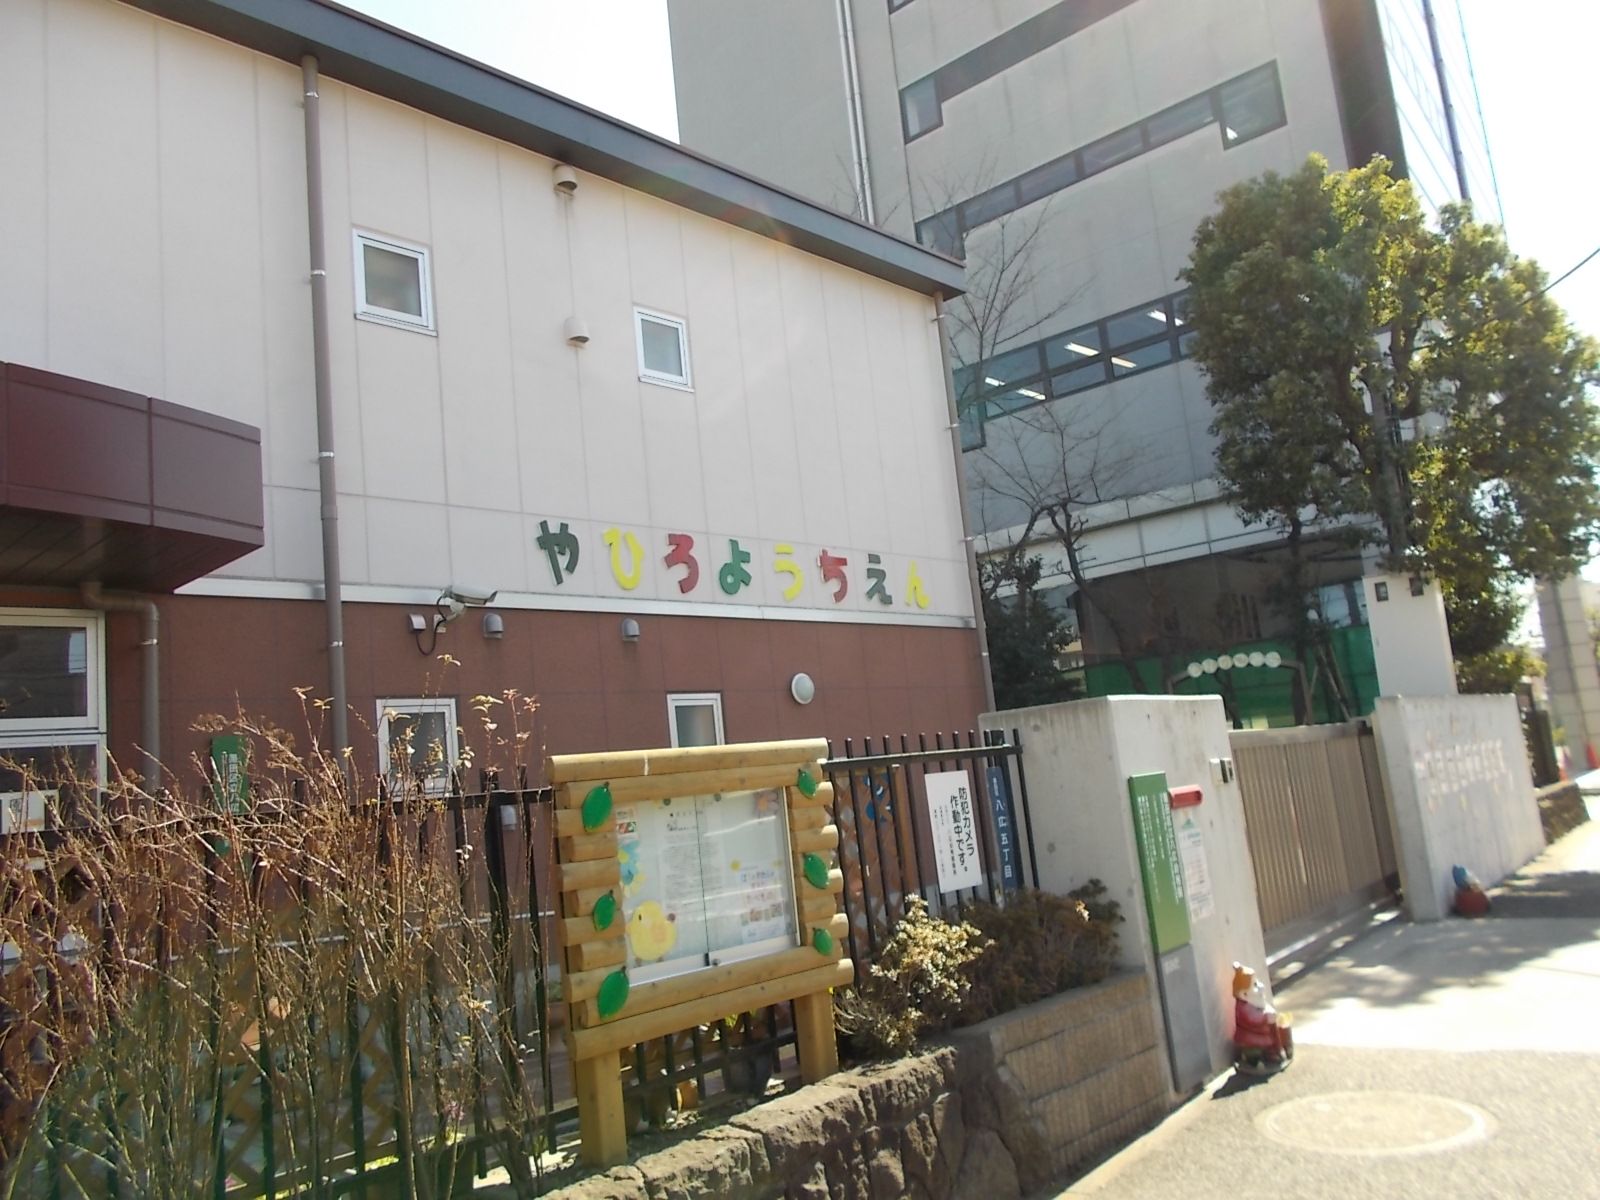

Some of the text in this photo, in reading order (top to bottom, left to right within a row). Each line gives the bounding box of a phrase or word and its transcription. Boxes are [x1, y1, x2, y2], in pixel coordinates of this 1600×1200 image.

[536, 519, 930, 609] やひろようちえん
[950, 795, 969, 872] 作動中です。
[958, 786, 975, 857] 防犯カメラ
[996, 799, 1013, 879] 八広五丁目
